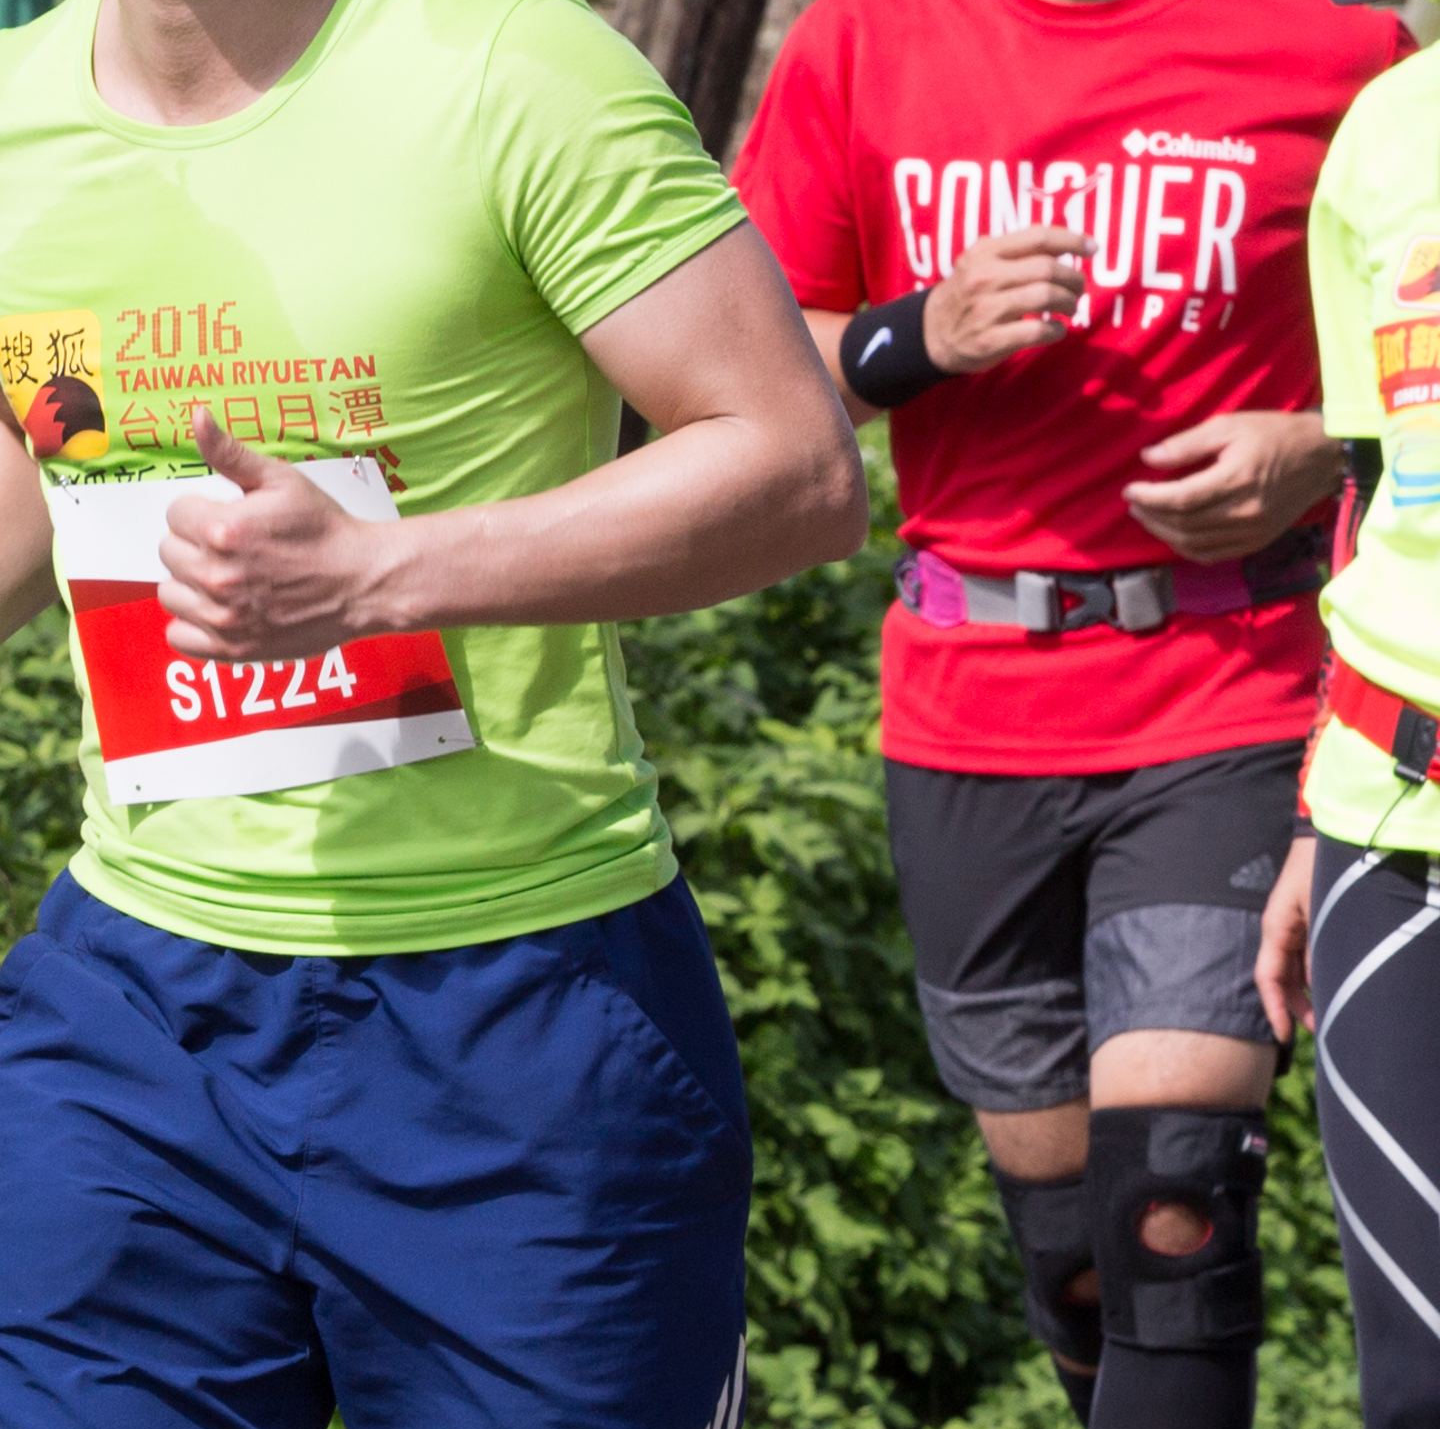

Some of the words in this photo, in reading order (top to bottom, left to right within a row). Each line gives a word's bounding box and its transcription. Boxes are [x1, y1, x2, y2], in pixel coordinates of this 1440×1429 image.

[1148, 131, 1255, 164] Columbia
[1, 328, 93, 384] 搜狐
[116, 301, 242, 362] 2016
[116, 365, 225, 394] TAIWAN
[233, 354, 377, 386] RIYUETAN
[166, 645, 357, 722] S1224
